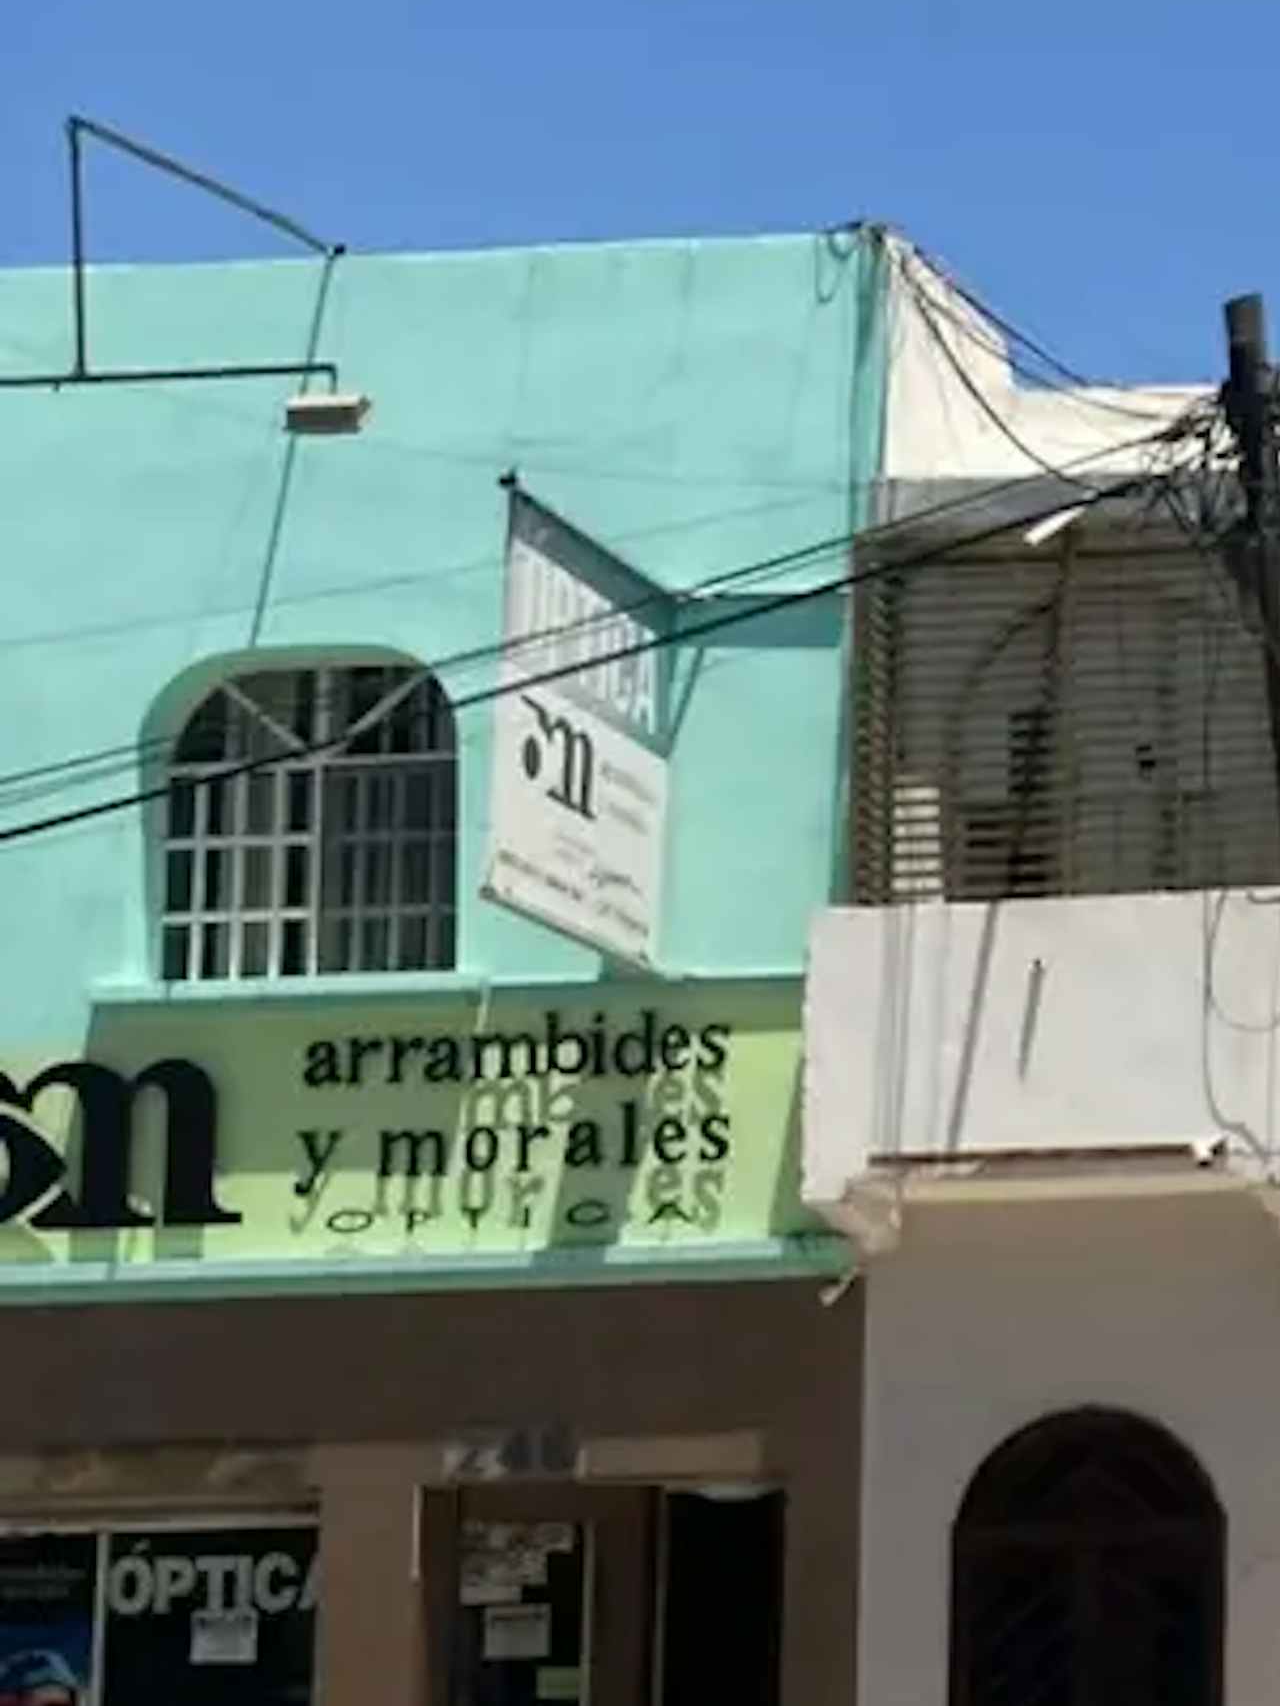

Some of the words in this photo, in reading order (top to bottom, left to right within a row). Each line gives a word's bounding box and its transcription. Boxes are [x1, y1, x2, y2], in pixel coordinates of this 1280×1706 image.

[302, 1008, 732, 1088] arrambides
[292, 1128, 340, 1196] y
[377, 1101, 731, 1178] morales
